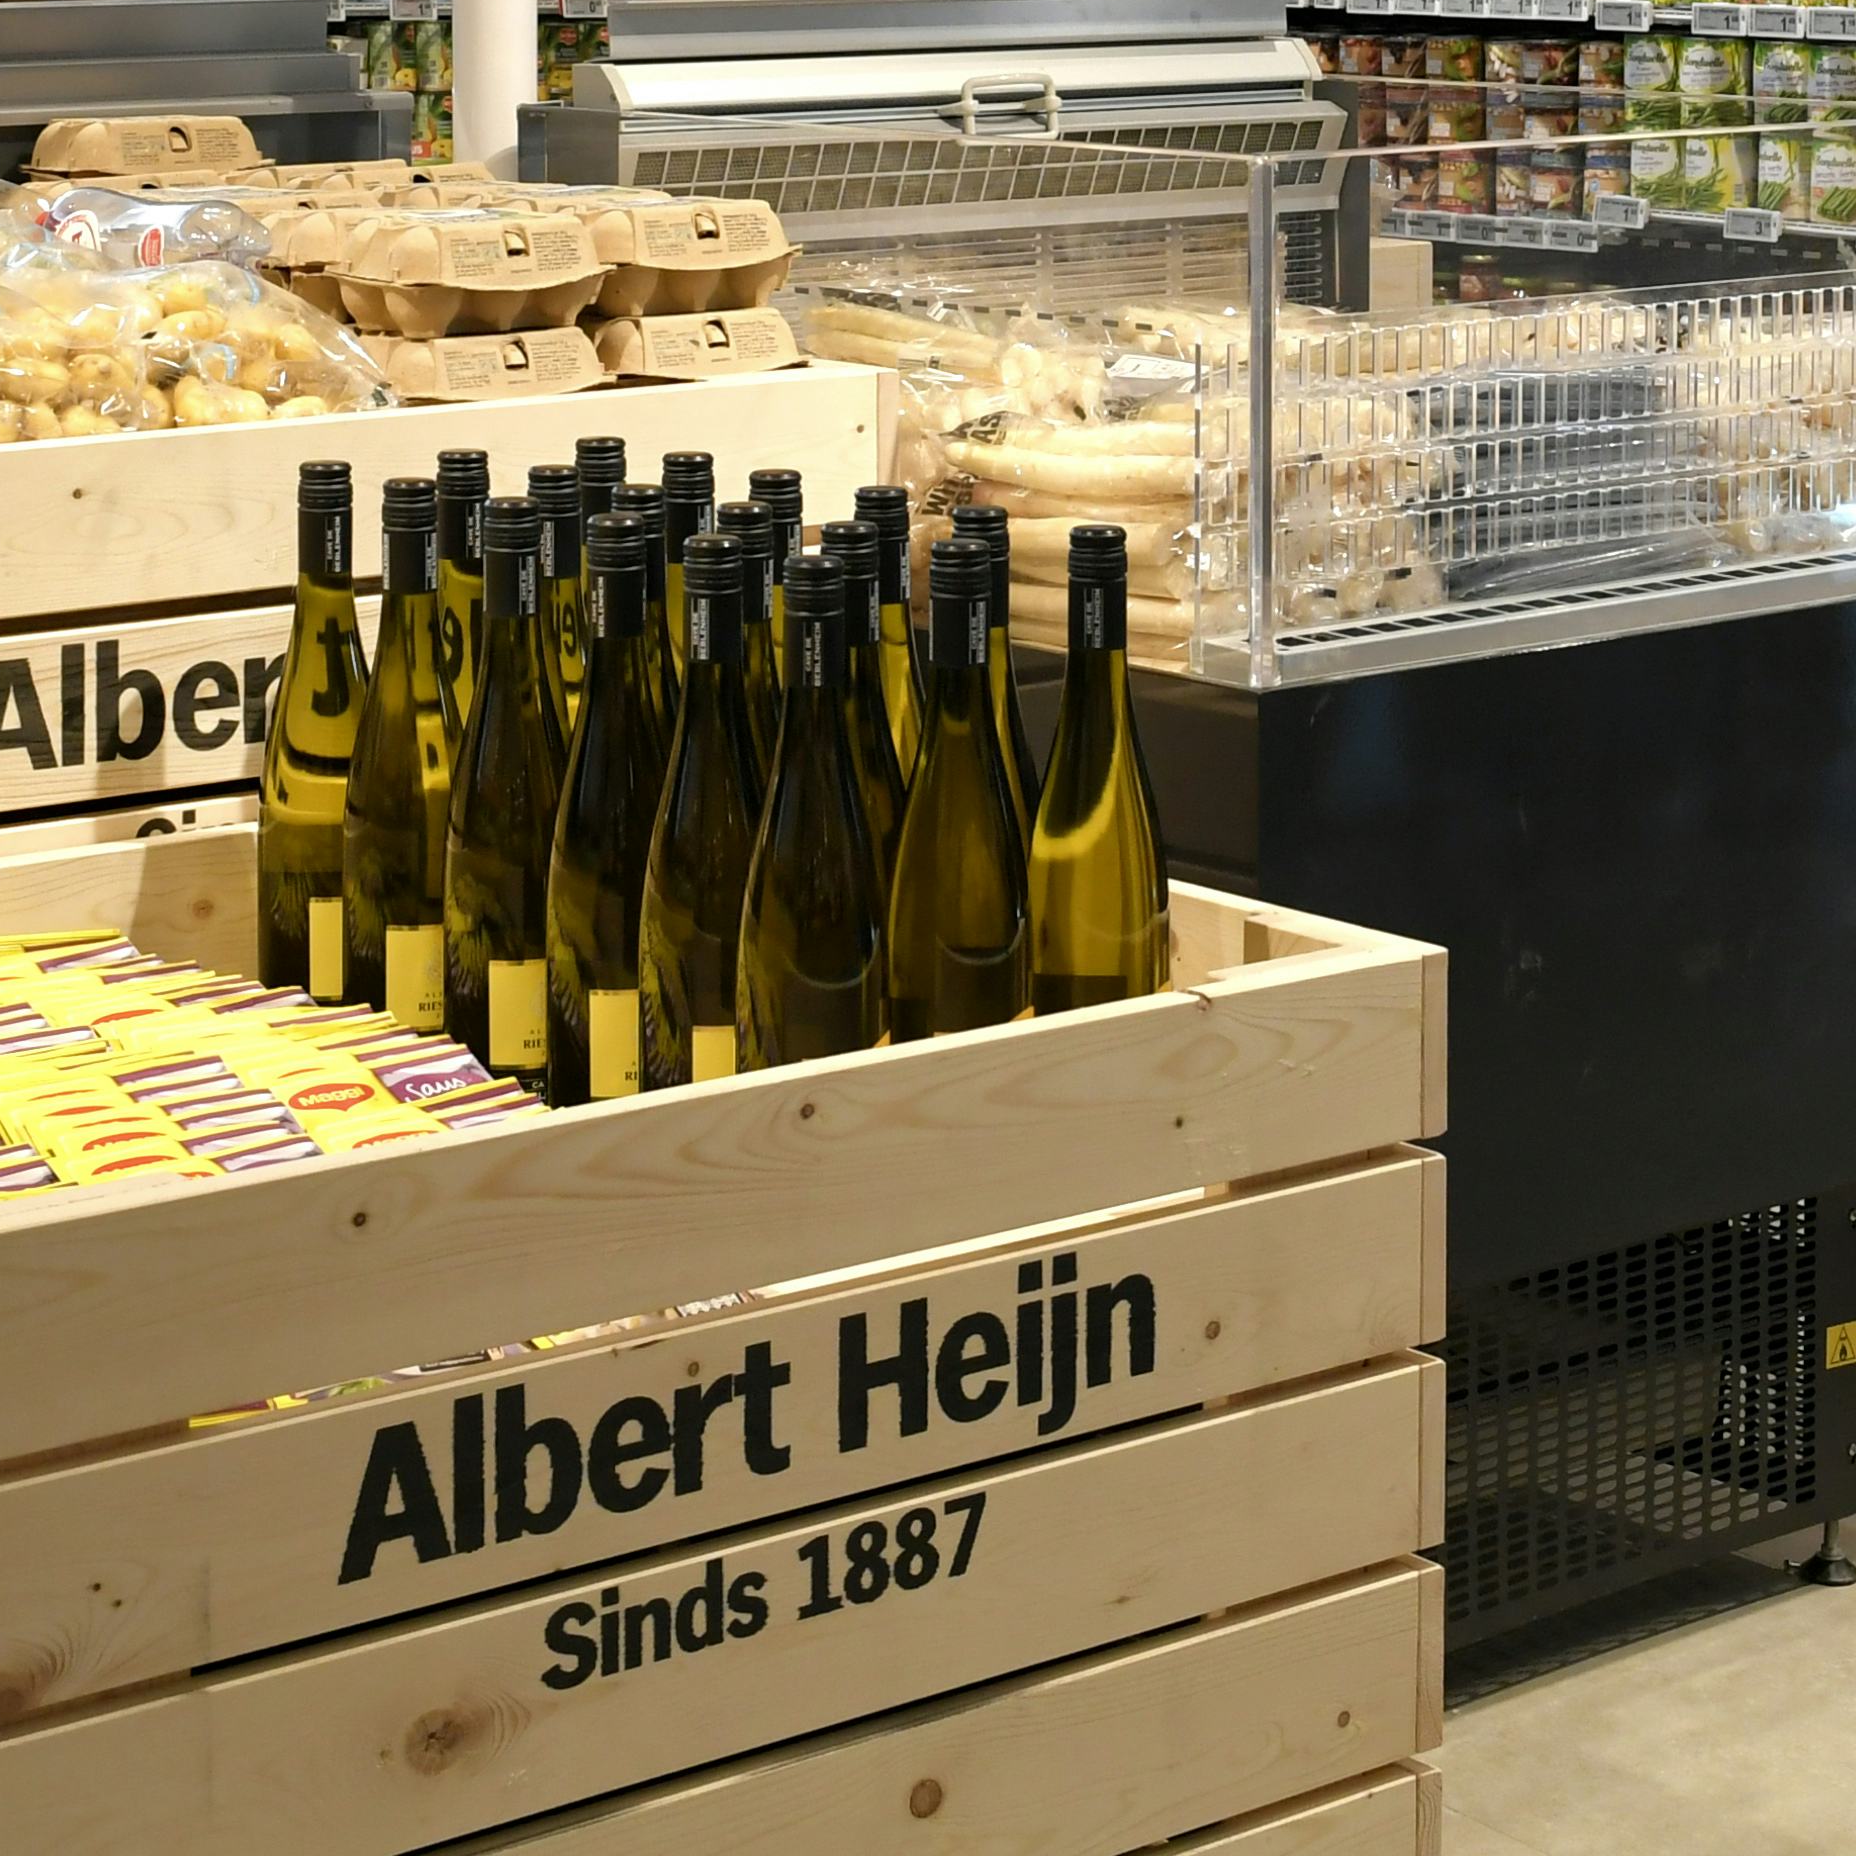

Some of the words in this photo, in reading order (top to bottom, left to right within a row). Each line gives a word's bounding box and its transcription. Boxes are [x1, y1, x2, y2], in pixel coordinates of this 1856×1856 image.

[300, 1083, 364, 1108] Maggi
[405, 1073, 467, 1103] Saus
[336, 1339, 792, 1586] Albert
[836, 1252, 1156, 1453] Heijn
[542, 1558, 768, 1691] Sinds
[796, 1491, 988, 1621] 1887
